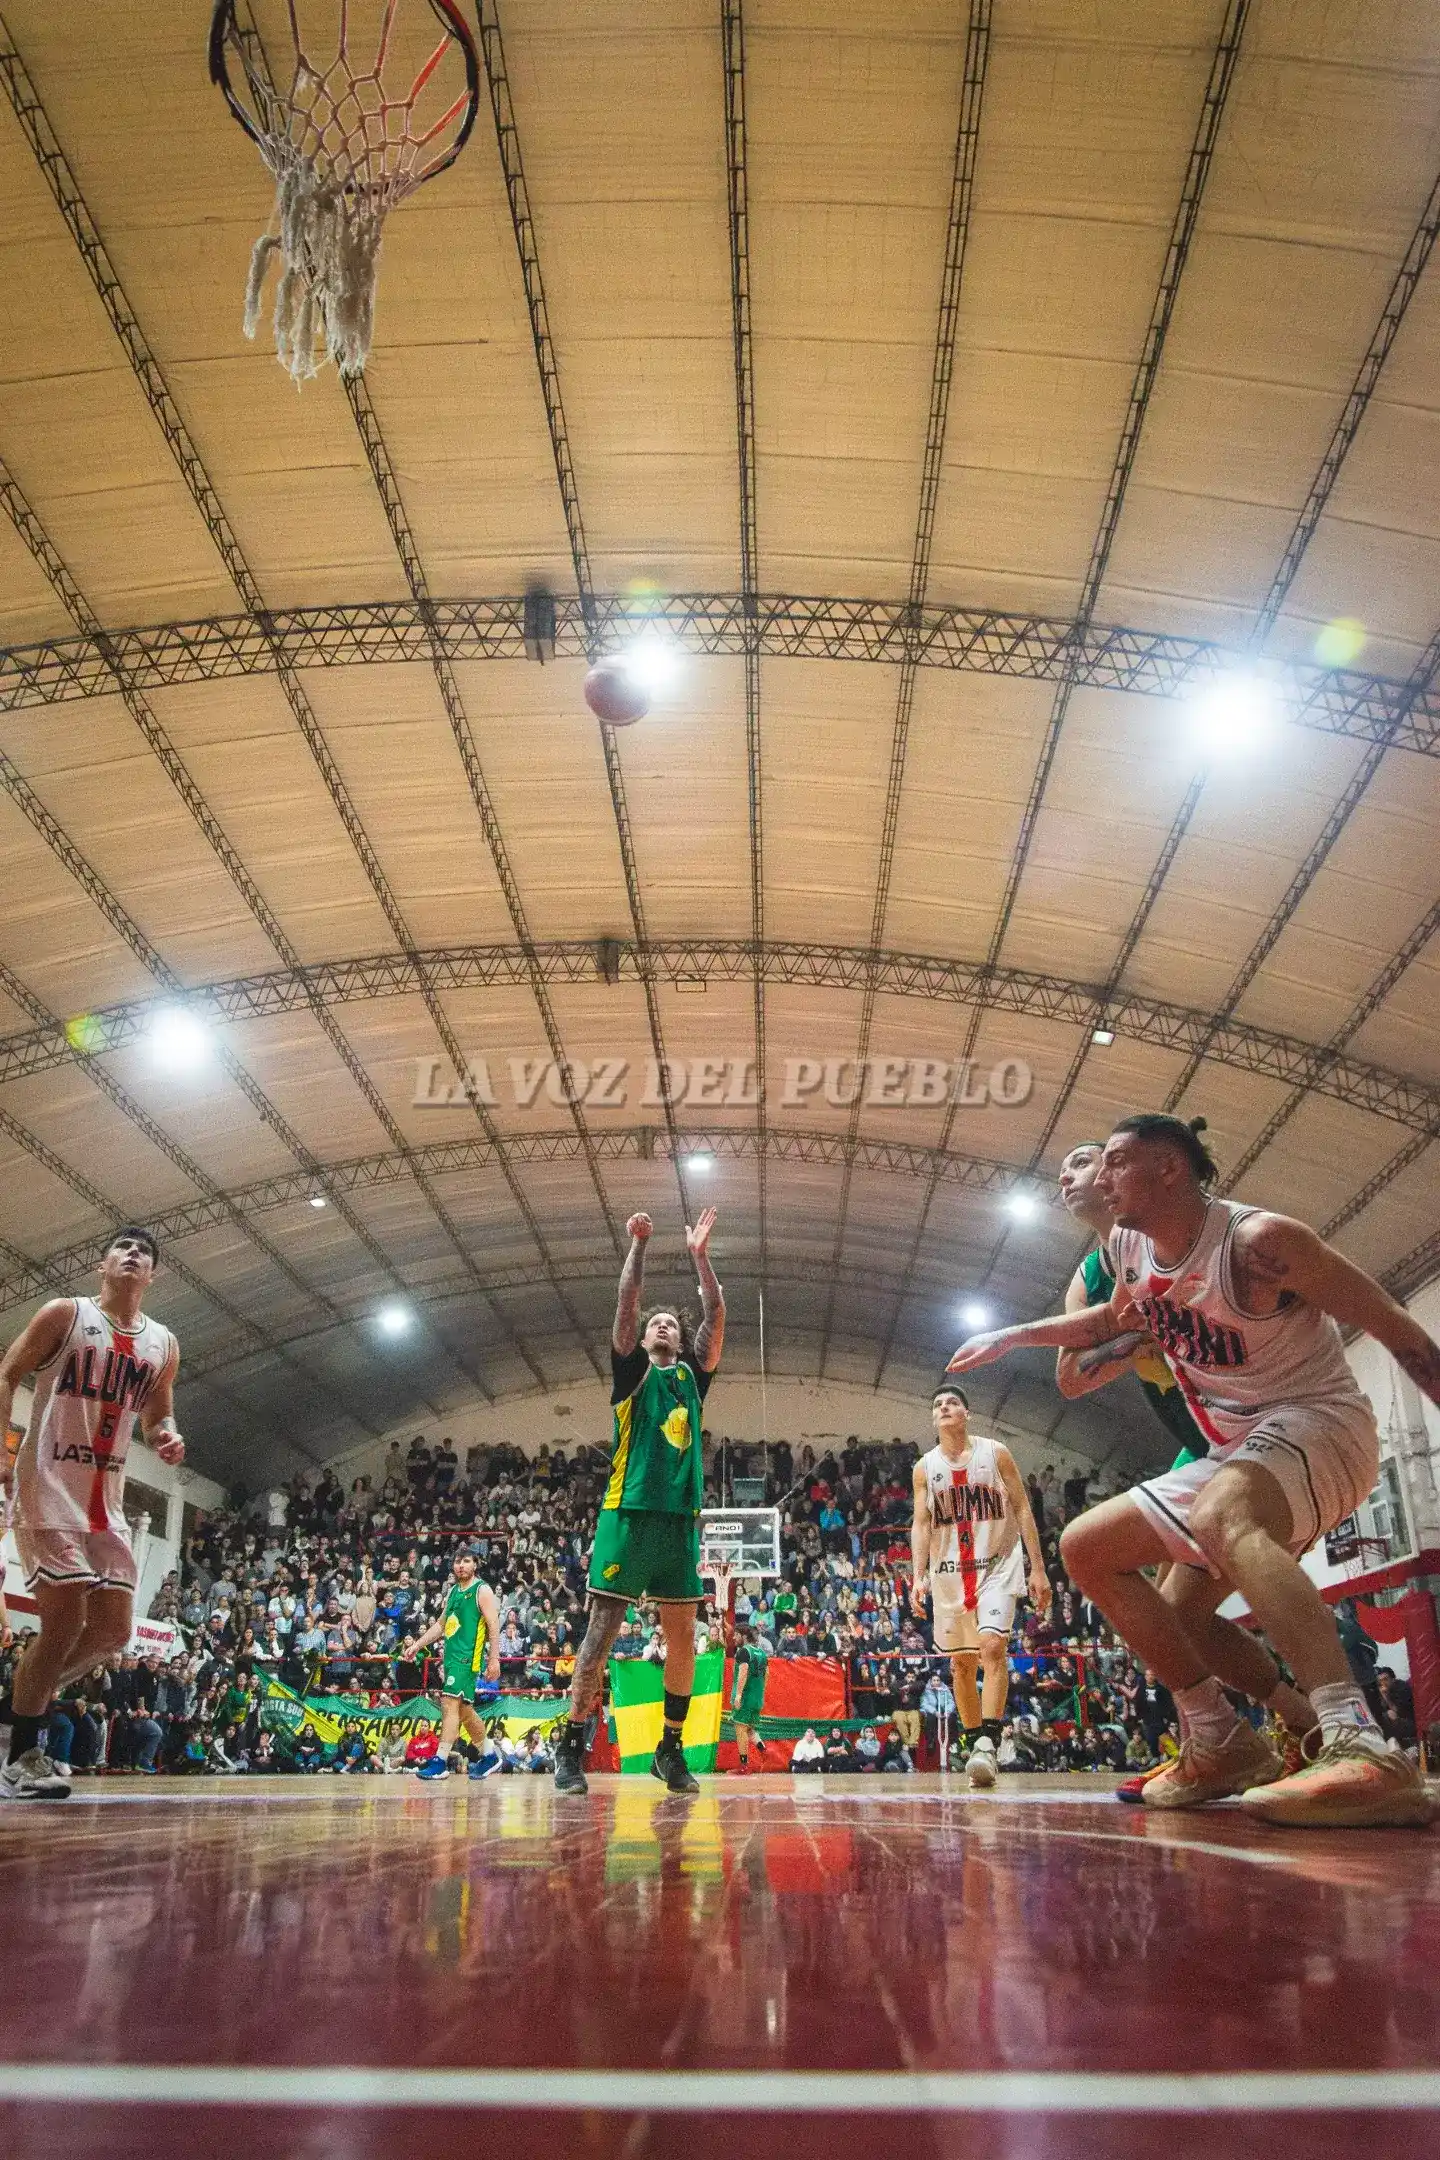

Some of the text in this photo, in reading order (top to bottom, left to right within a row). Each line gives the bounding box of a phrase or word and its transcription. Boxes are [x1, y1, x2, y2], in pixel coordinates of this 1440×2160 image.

[57, 1345, 157, 1413] ALUM
[101, 1412, 117, 1439] 5
[960, 1530, 974, 1549] 4
